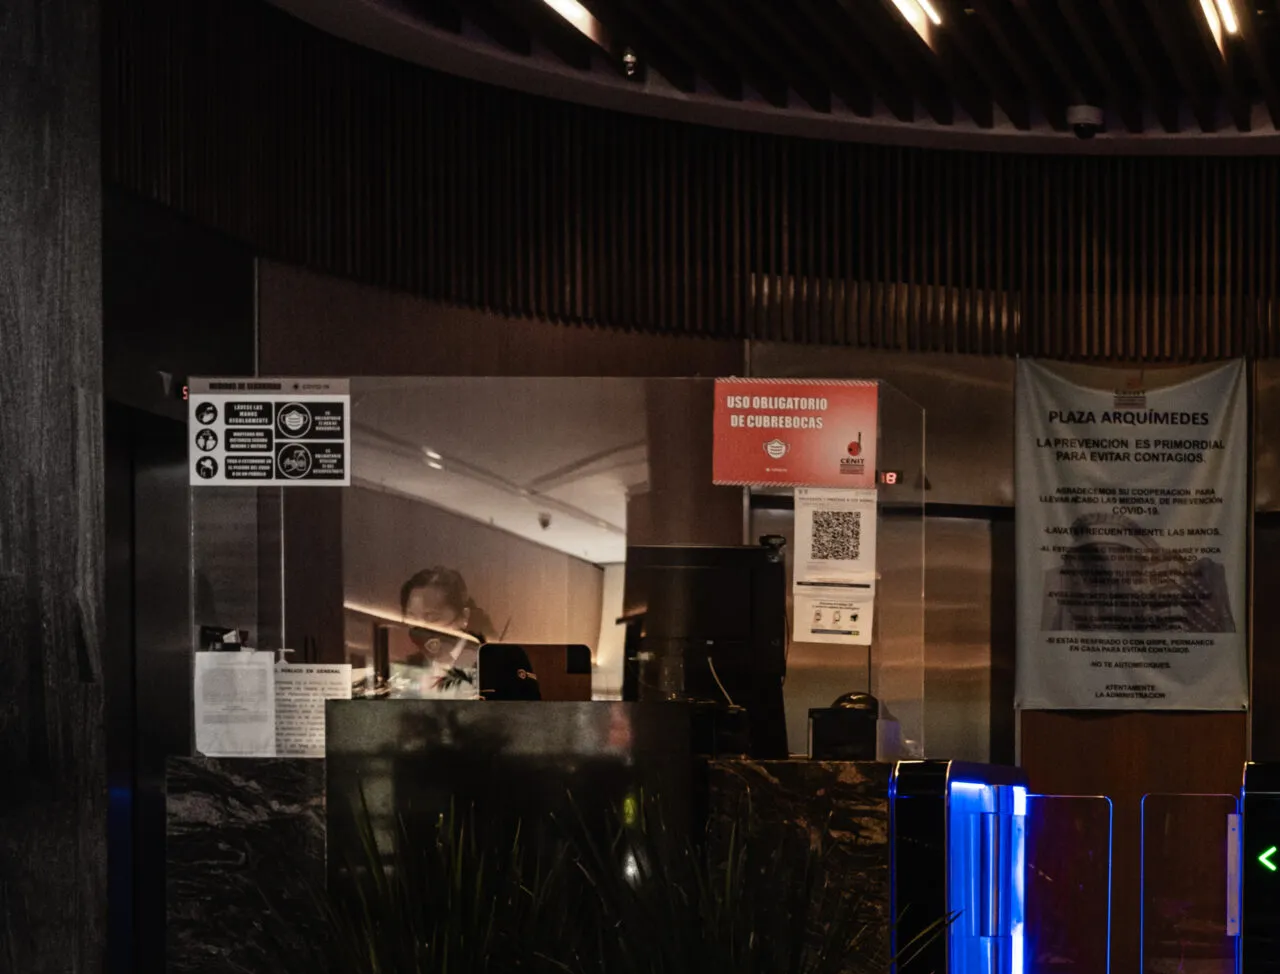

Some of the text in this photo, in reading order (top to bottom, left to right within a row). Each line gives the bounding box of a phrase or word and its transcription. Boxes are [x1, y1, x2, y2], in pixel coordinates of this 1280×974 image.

[727, 396, 828, 410] USO OBLIGATORIO
[730, 415, 824, 429] DE CUBREBOCAS
[1049, 408, 1209, 426] PLAZA ARQUÍMEDES
[1036, 438, 1052, 448] LA
[1135, 439, 1150, 449] ES
[1154, 439, 1225, 450] PRIMORDIAL
[1056, 451, 1087, 462] PARA
[1090, 451, 1131, 462] EVITAR
